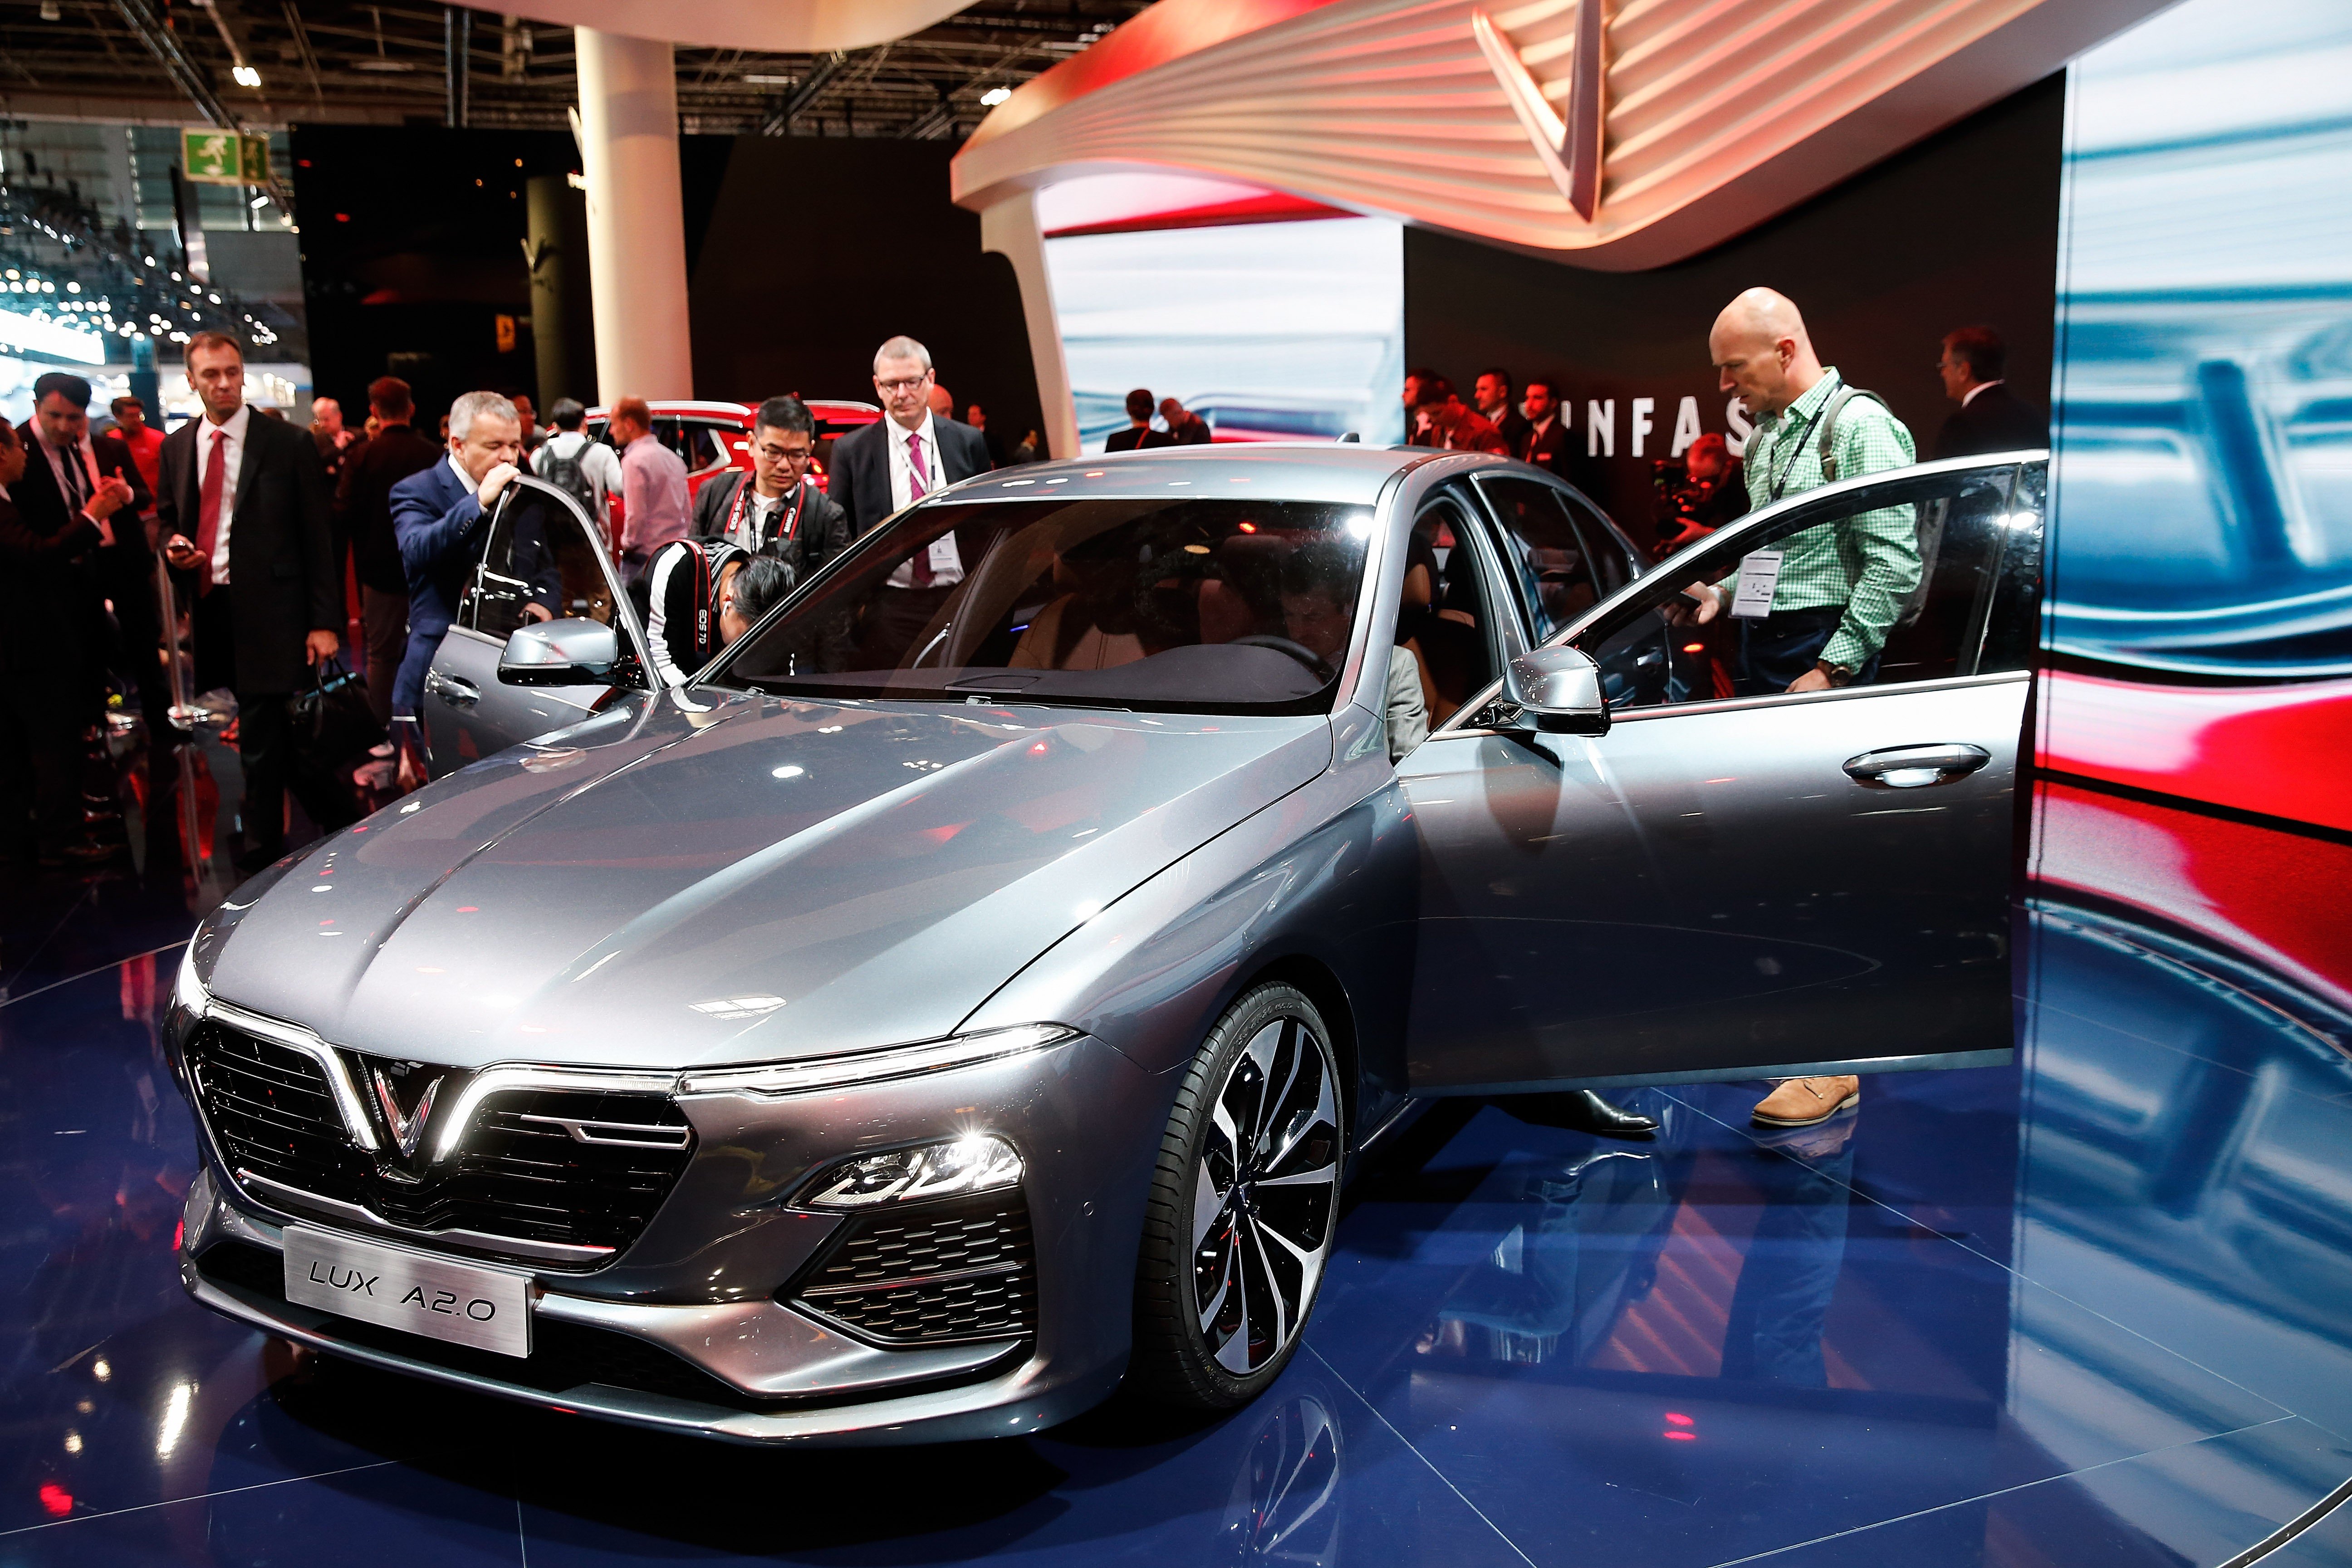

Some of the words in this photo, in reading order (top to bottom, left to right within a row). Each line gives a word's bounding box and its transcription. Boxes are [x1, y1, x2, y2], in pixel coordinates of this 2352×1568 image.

[729, 511, 740, 530] EOS
[699, 609, 707, 632] EOS
[699, 632, 706, 644] 7D
[308, 1260, 380, 1296] LUX
[399, 1285, 496, 1322] A2.0
